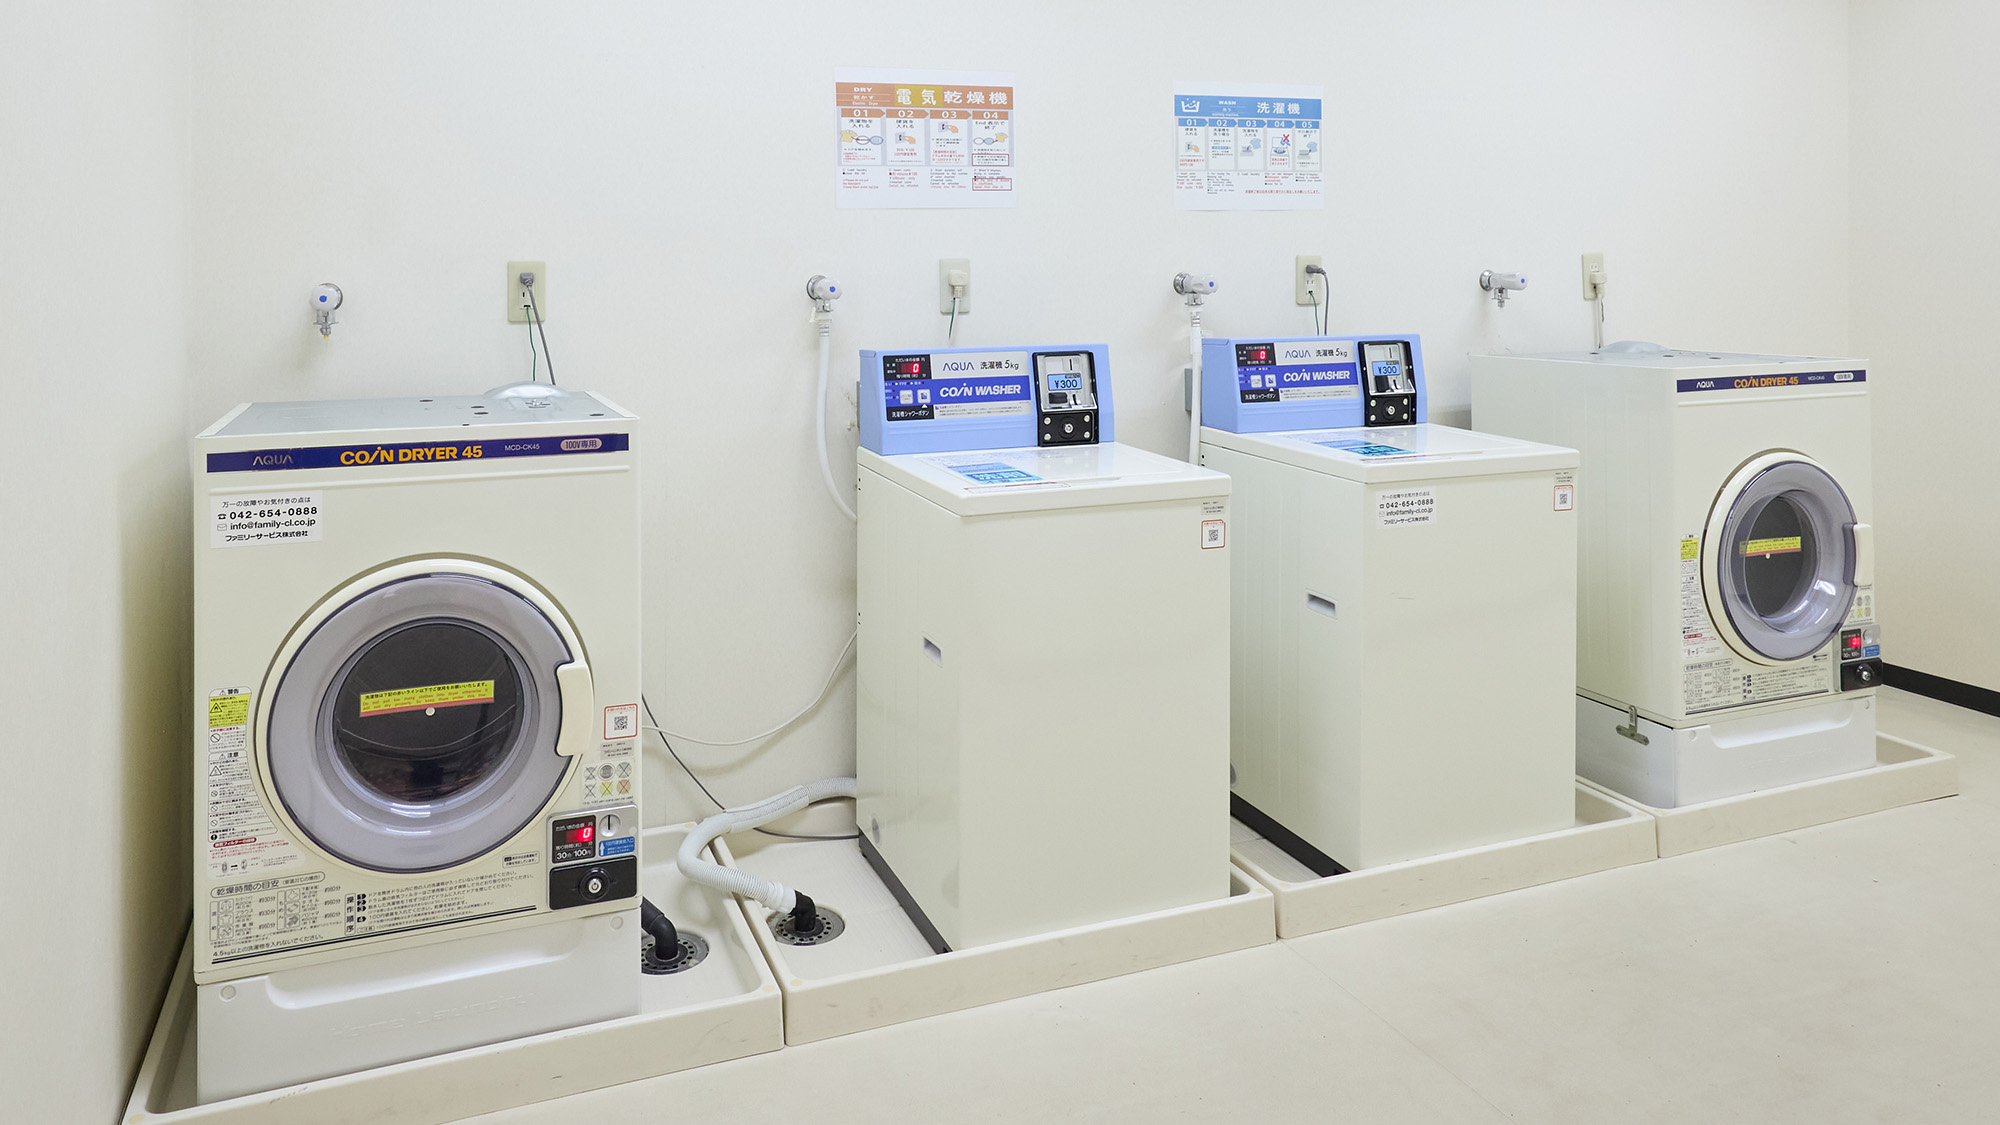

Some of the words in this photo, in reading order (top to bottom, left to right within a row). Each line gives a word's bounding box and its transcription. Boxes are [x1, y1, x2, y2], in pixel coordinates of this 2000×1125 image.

[853, 109, 868, 118] 01
[898, 110, 914, 118] 02
[1256, 102, 1300, 115] 洗濯機
[941, 110, 957, 119] 03
[983, 111, 999, 120] 04
[1216, 119, 1227, 127] 02
[1274, 120, 1285, 128] 04
[1260, 350, 1266, 360] 0
[1285, 349, 1311, 359] AQUA
[1316, 349, 1334, 357] 洗濯機
[1336, 348, 1347, 358] 5kg
[912, 363, 920, 373] 0
[943, 361, 975, 372] AQUA
[980, 361, 1003, 370] 洗濯機
[1004, 359, 1019, 371] 5kg
[1283, 369, 1310, 382] COIN
[1312, 370, 1350, 380] WASHER
[1696, 380, 1715, 389] AQUA
[1760, 377, 1788, 387] DRYER
[1789, 376, 1799, 385] 45
[940, 383, 973, 398] COIN
[975, 384, 1022, 396] WASHER
[253, 455, 294, 466] AQUA
[340, 446, 394, 466] COIN
[399, 446, 458, 462] DRYER
[462, 445, 483, 459] 45
[504, 443, 540, 451] MCD-CK45
[565, 440, 597, 449] 100V専用
[222, 497, 311, 508] 万一の故障やお気付きの点は
[1386, 498, 1434, 509] 042-654-0888
[229, 506, 318, 520] 042-654-0888
[230, 518, 316, 531] info@family-cl.co.jp
[225, 530, 309, 542] ファミリーサービス株式会社
[583, 827, 592, 838] 0
[216, 880, 279, 896] 乾燥時間の目安
